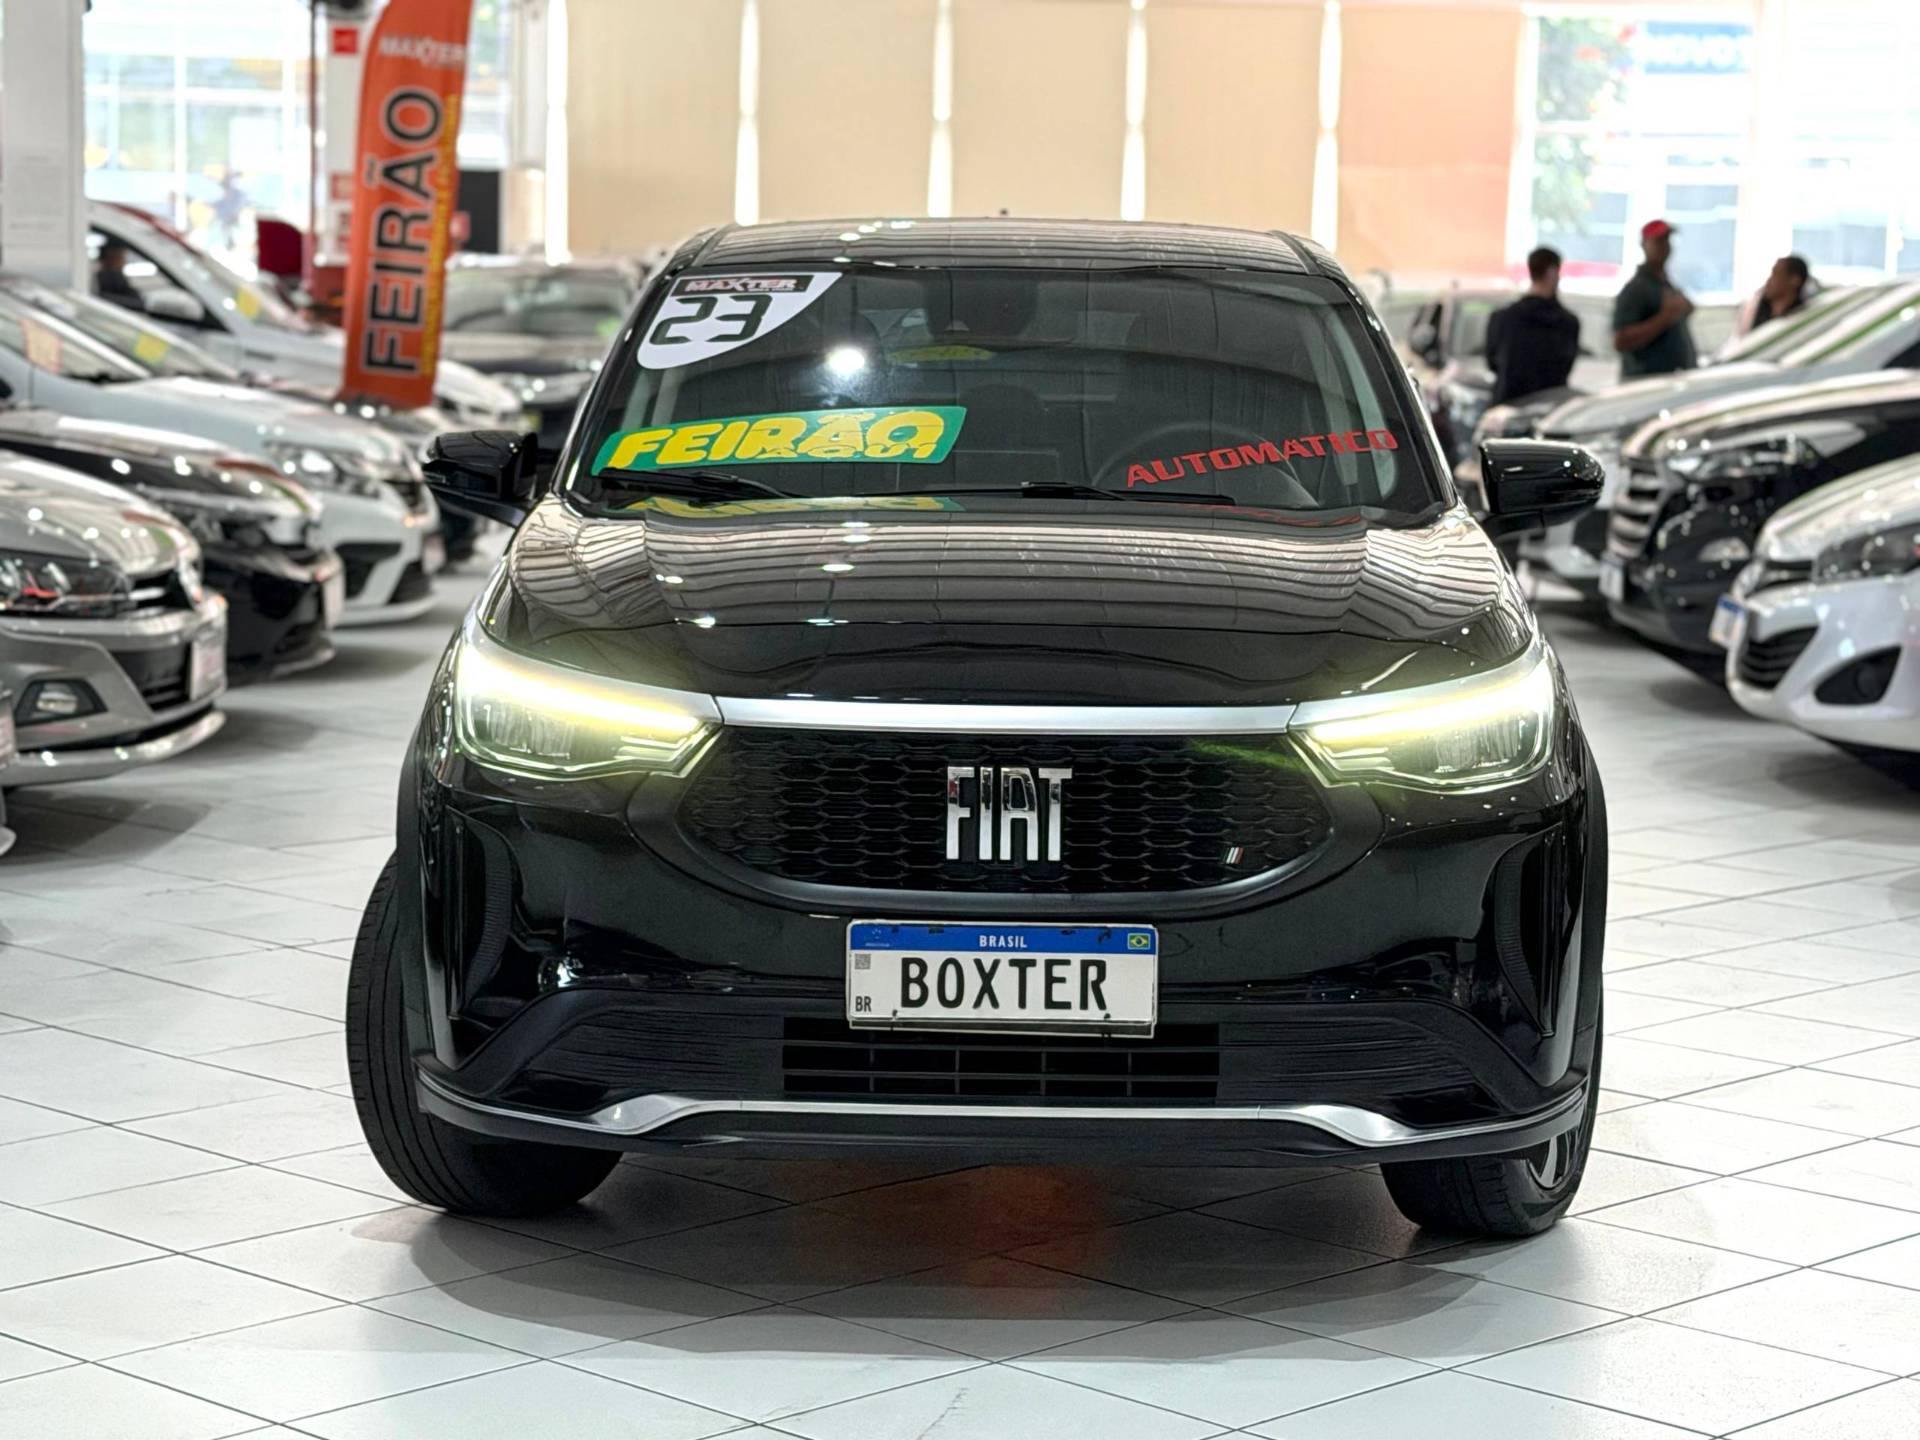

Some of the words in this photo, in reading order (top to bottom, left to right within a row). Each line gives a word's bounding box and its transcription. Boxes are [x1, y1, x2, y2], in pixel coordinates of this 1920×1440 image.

[364, 90, 443, 372] FEIRÃO
[685, 279, 797, 292] MAXTER
[650, 294, 773, 345] 23
[608, 411, 944, 469] FEIRÃO
[946, 766, 1072, 861] FIAT
[979, 935, 1027, 948] BRASIL
[855, 996, 871, 1012] BR
[901, 957, 1107, 1010] BOXTER
